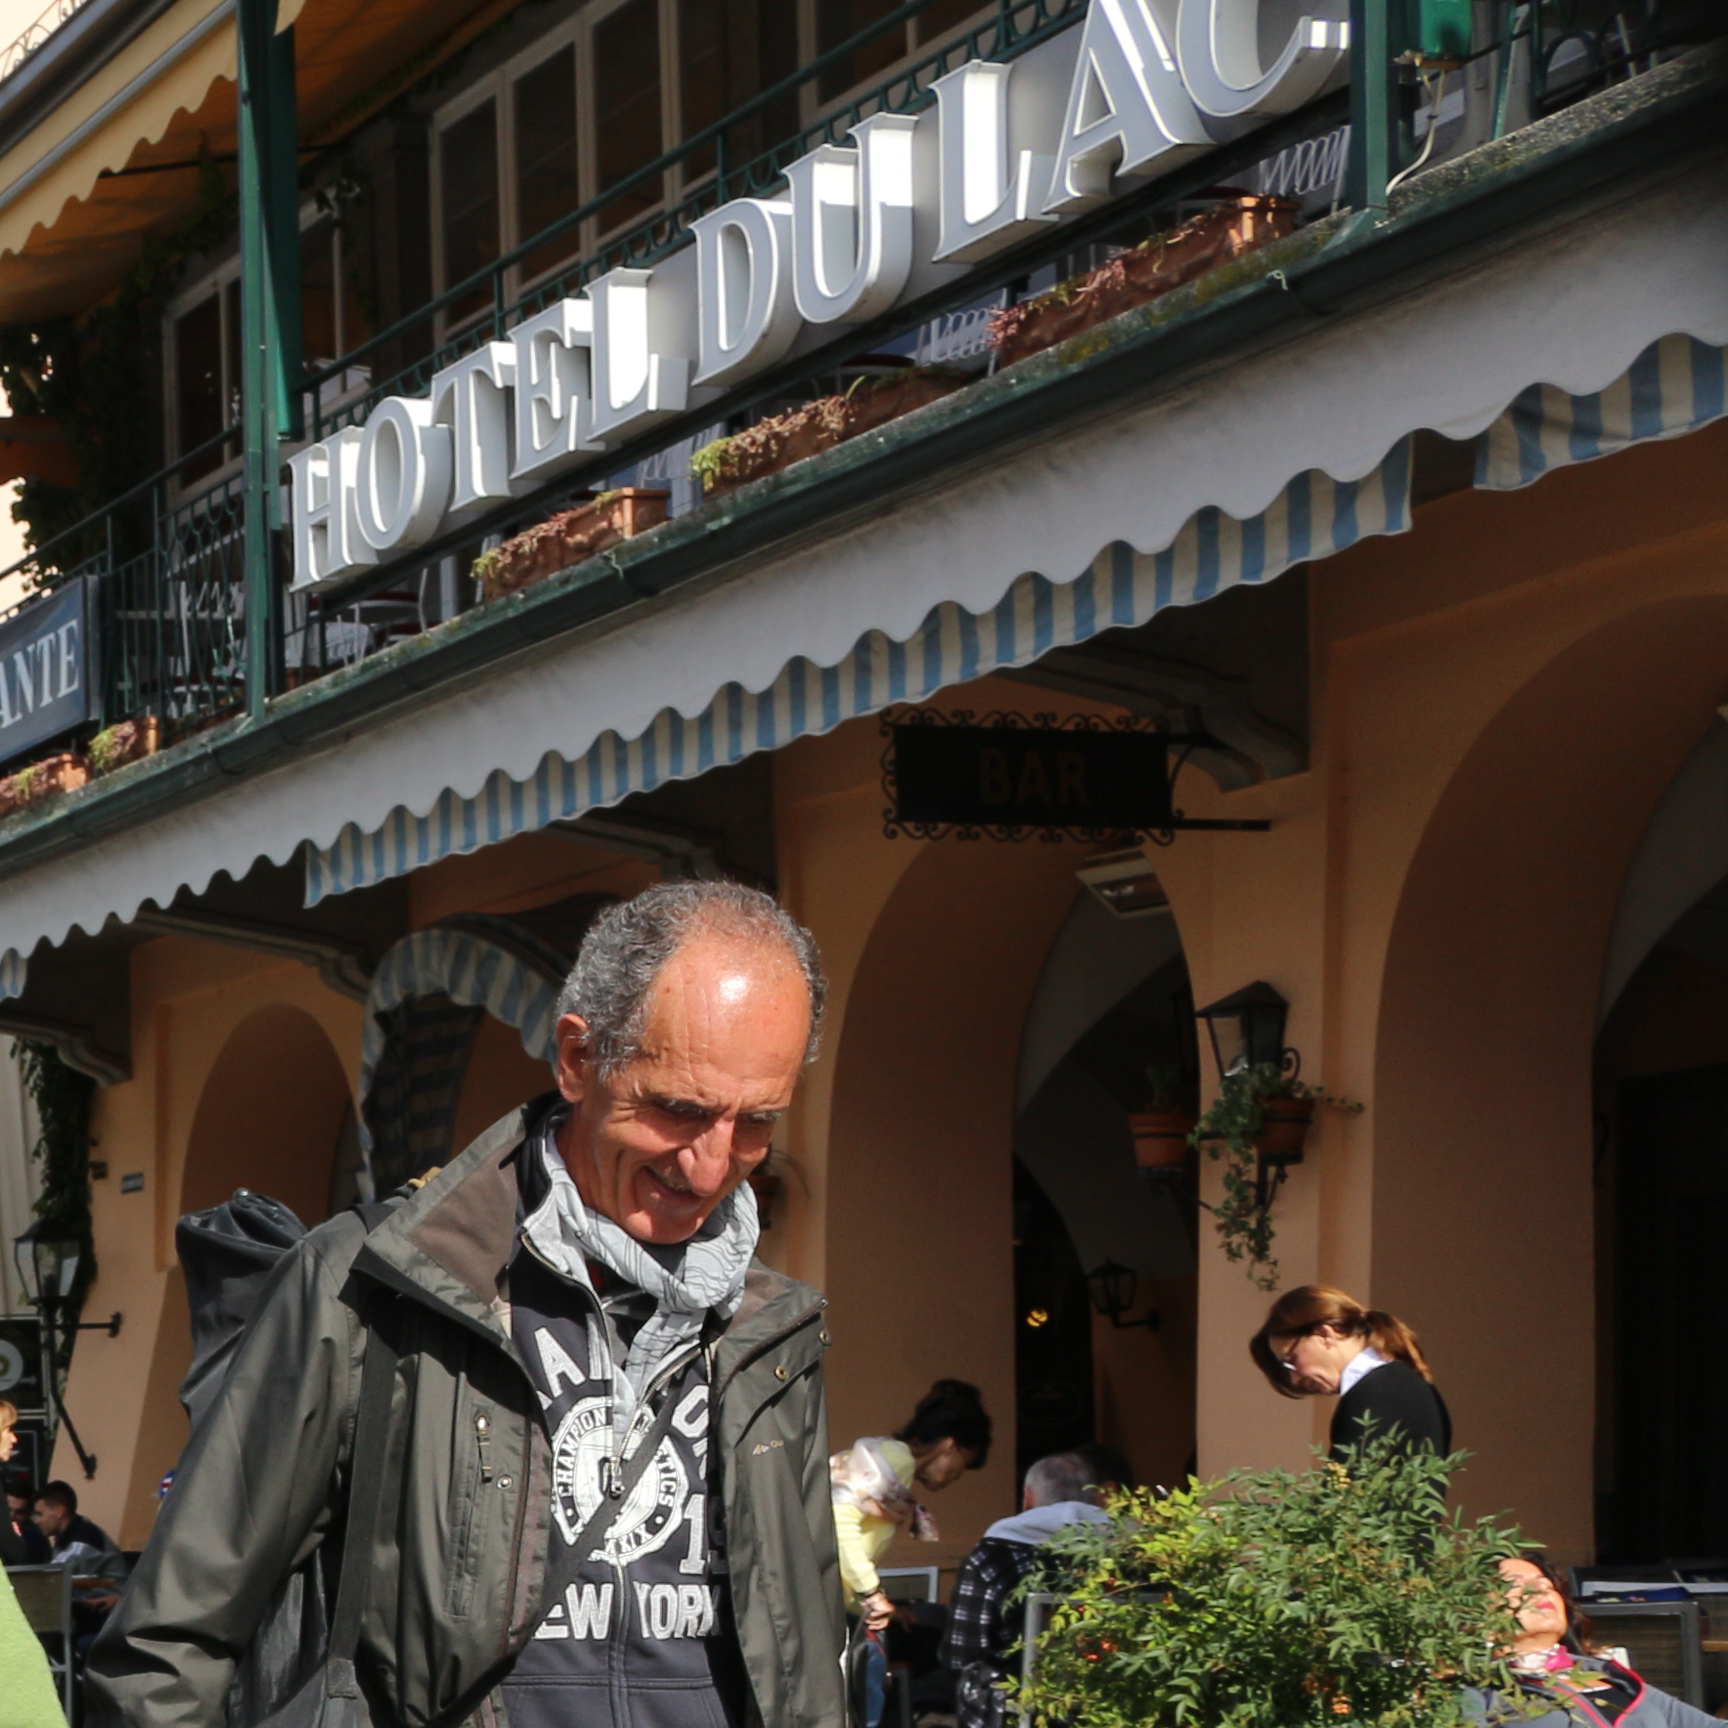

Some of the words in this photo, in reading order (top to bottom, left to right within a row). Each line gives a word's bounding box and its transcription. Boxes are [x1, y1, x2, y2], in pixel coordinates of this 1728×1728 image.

[286, 268, 690, 593] HOTEL
[690, 112, 918, 386] DU
[929, 0, 1348, 263] LAC
[977, 747, 1089, 808] BAR
[633, 1581, 721, 1640] YORK
